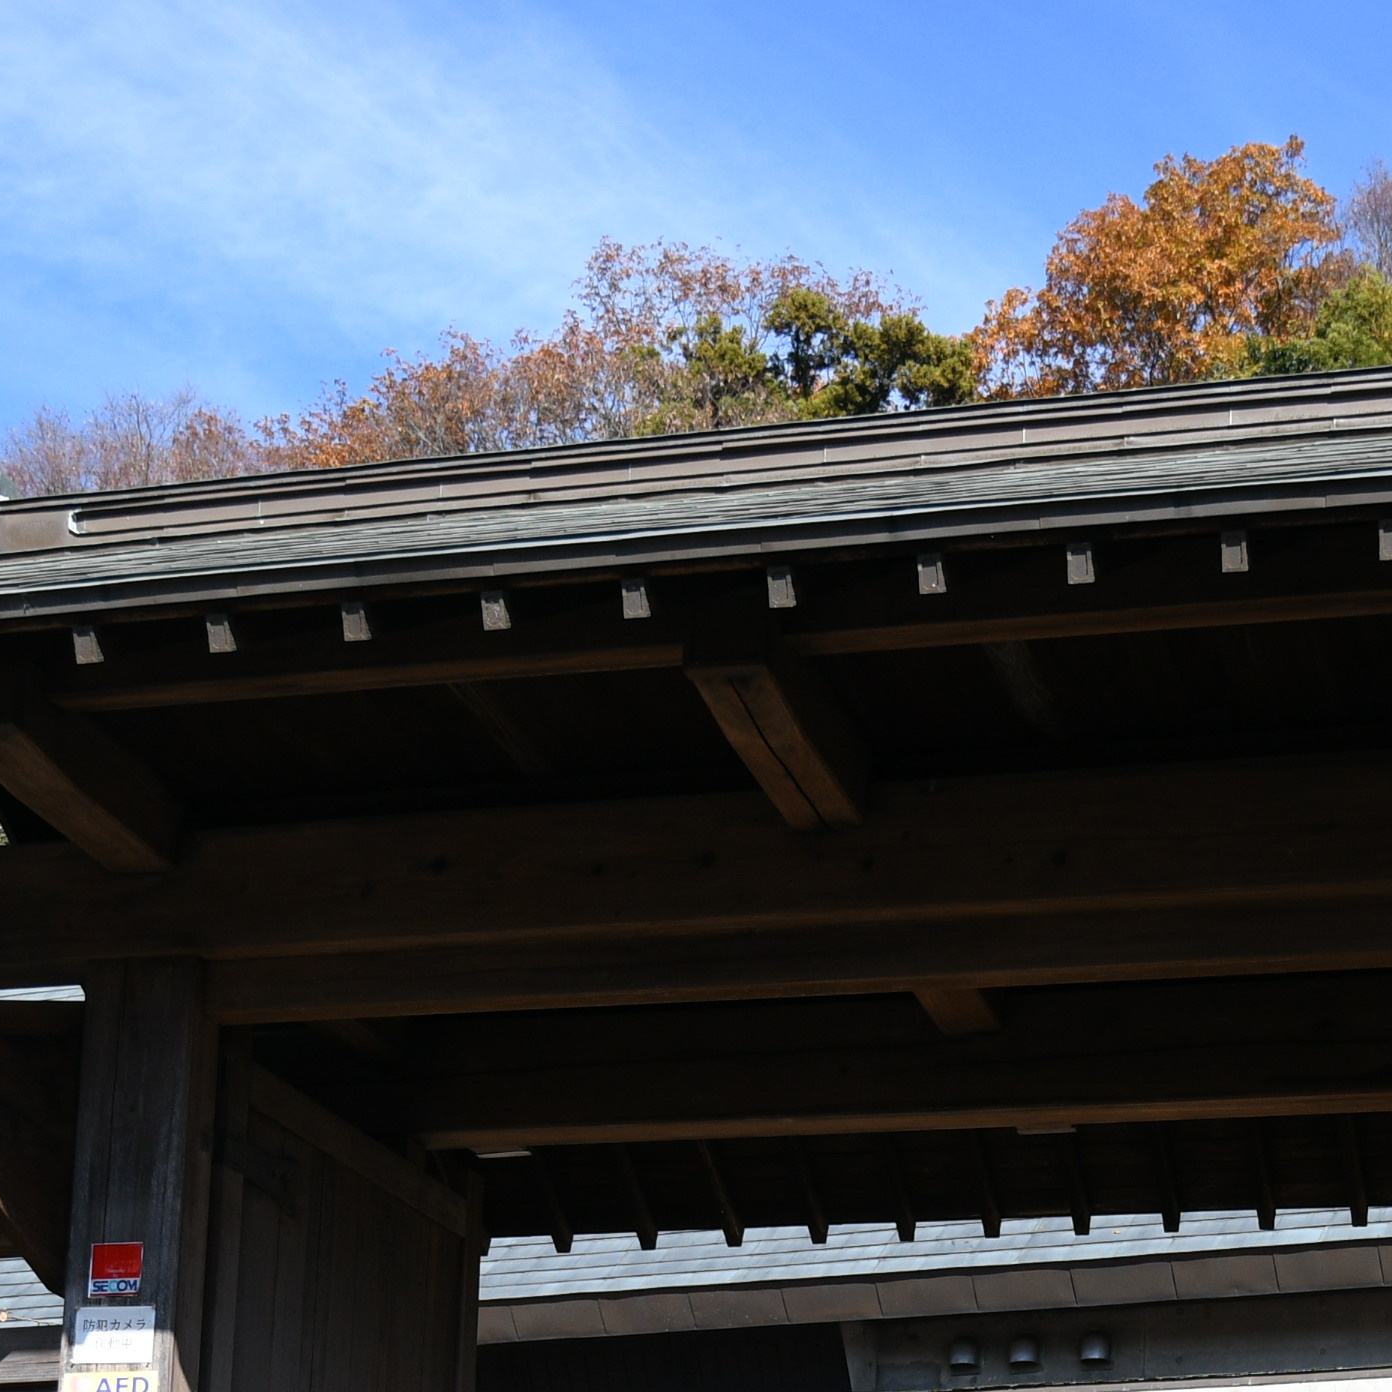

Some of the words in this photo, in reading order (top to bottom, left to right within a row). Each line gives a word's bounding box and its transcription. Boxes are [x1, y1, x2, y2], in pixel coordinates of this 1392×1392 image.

[93, 1280, 137, 1292] SECOM
[83, 1319, 146, 1333] 防犯カメラ
